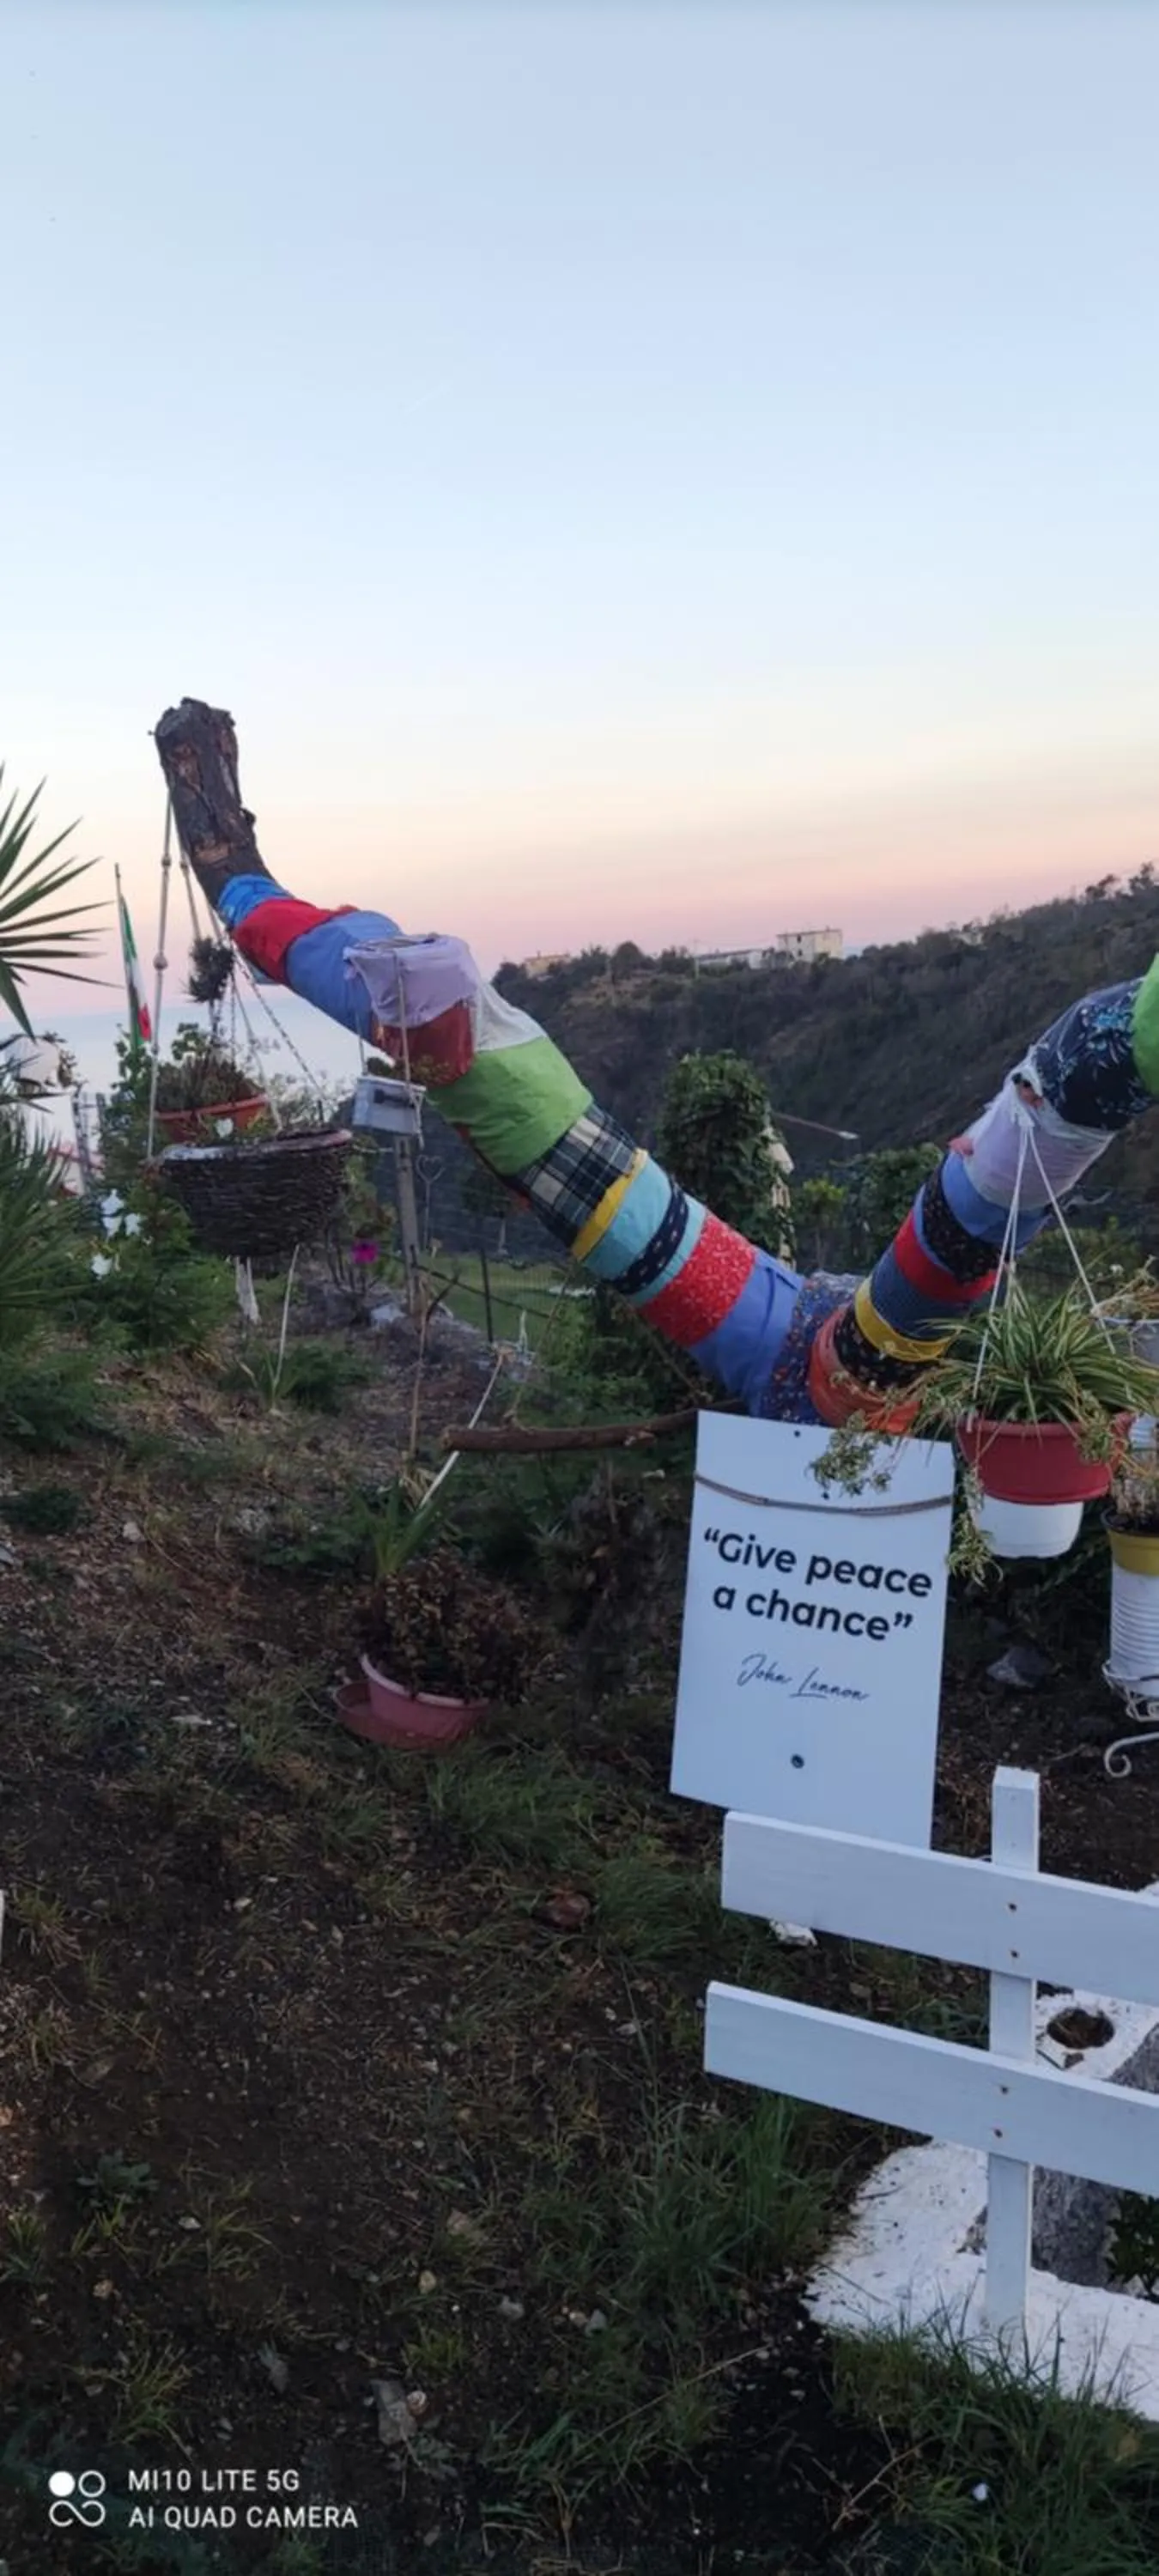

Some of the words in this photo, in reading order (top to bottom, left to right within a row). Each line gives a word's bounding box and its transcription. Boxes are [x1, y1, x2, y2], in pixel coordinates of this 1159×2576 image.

[804, 1554, 933, 1598] peace
[712, 1586, 737, 1611] a
[737, 1653, 793, 1687] John
[789, 1667, 871, 1701] Lennon
